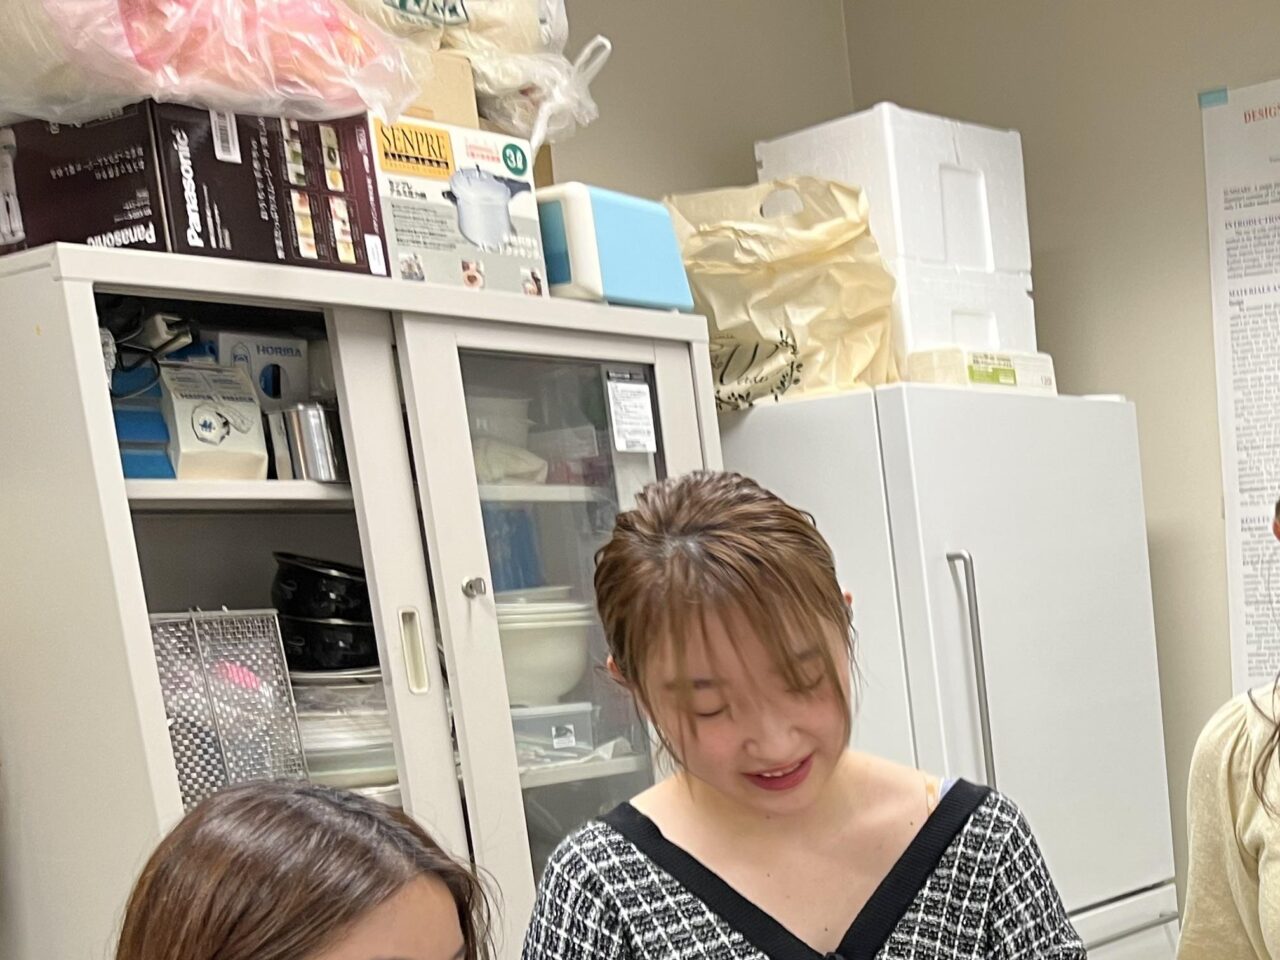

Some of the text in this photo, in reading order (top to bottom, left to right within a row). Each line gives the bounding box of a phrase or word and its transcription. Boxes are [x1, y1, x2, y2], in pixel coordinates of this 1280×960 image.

[381, 124, 448, 160] SENPRE
[170, 124, 204, 248] Panasonic
[86, 221, 157, 248] Panasonic
[1228, 284, 1270, 298] MATERIALS
[256, 344, 303, 358] HORIBA
